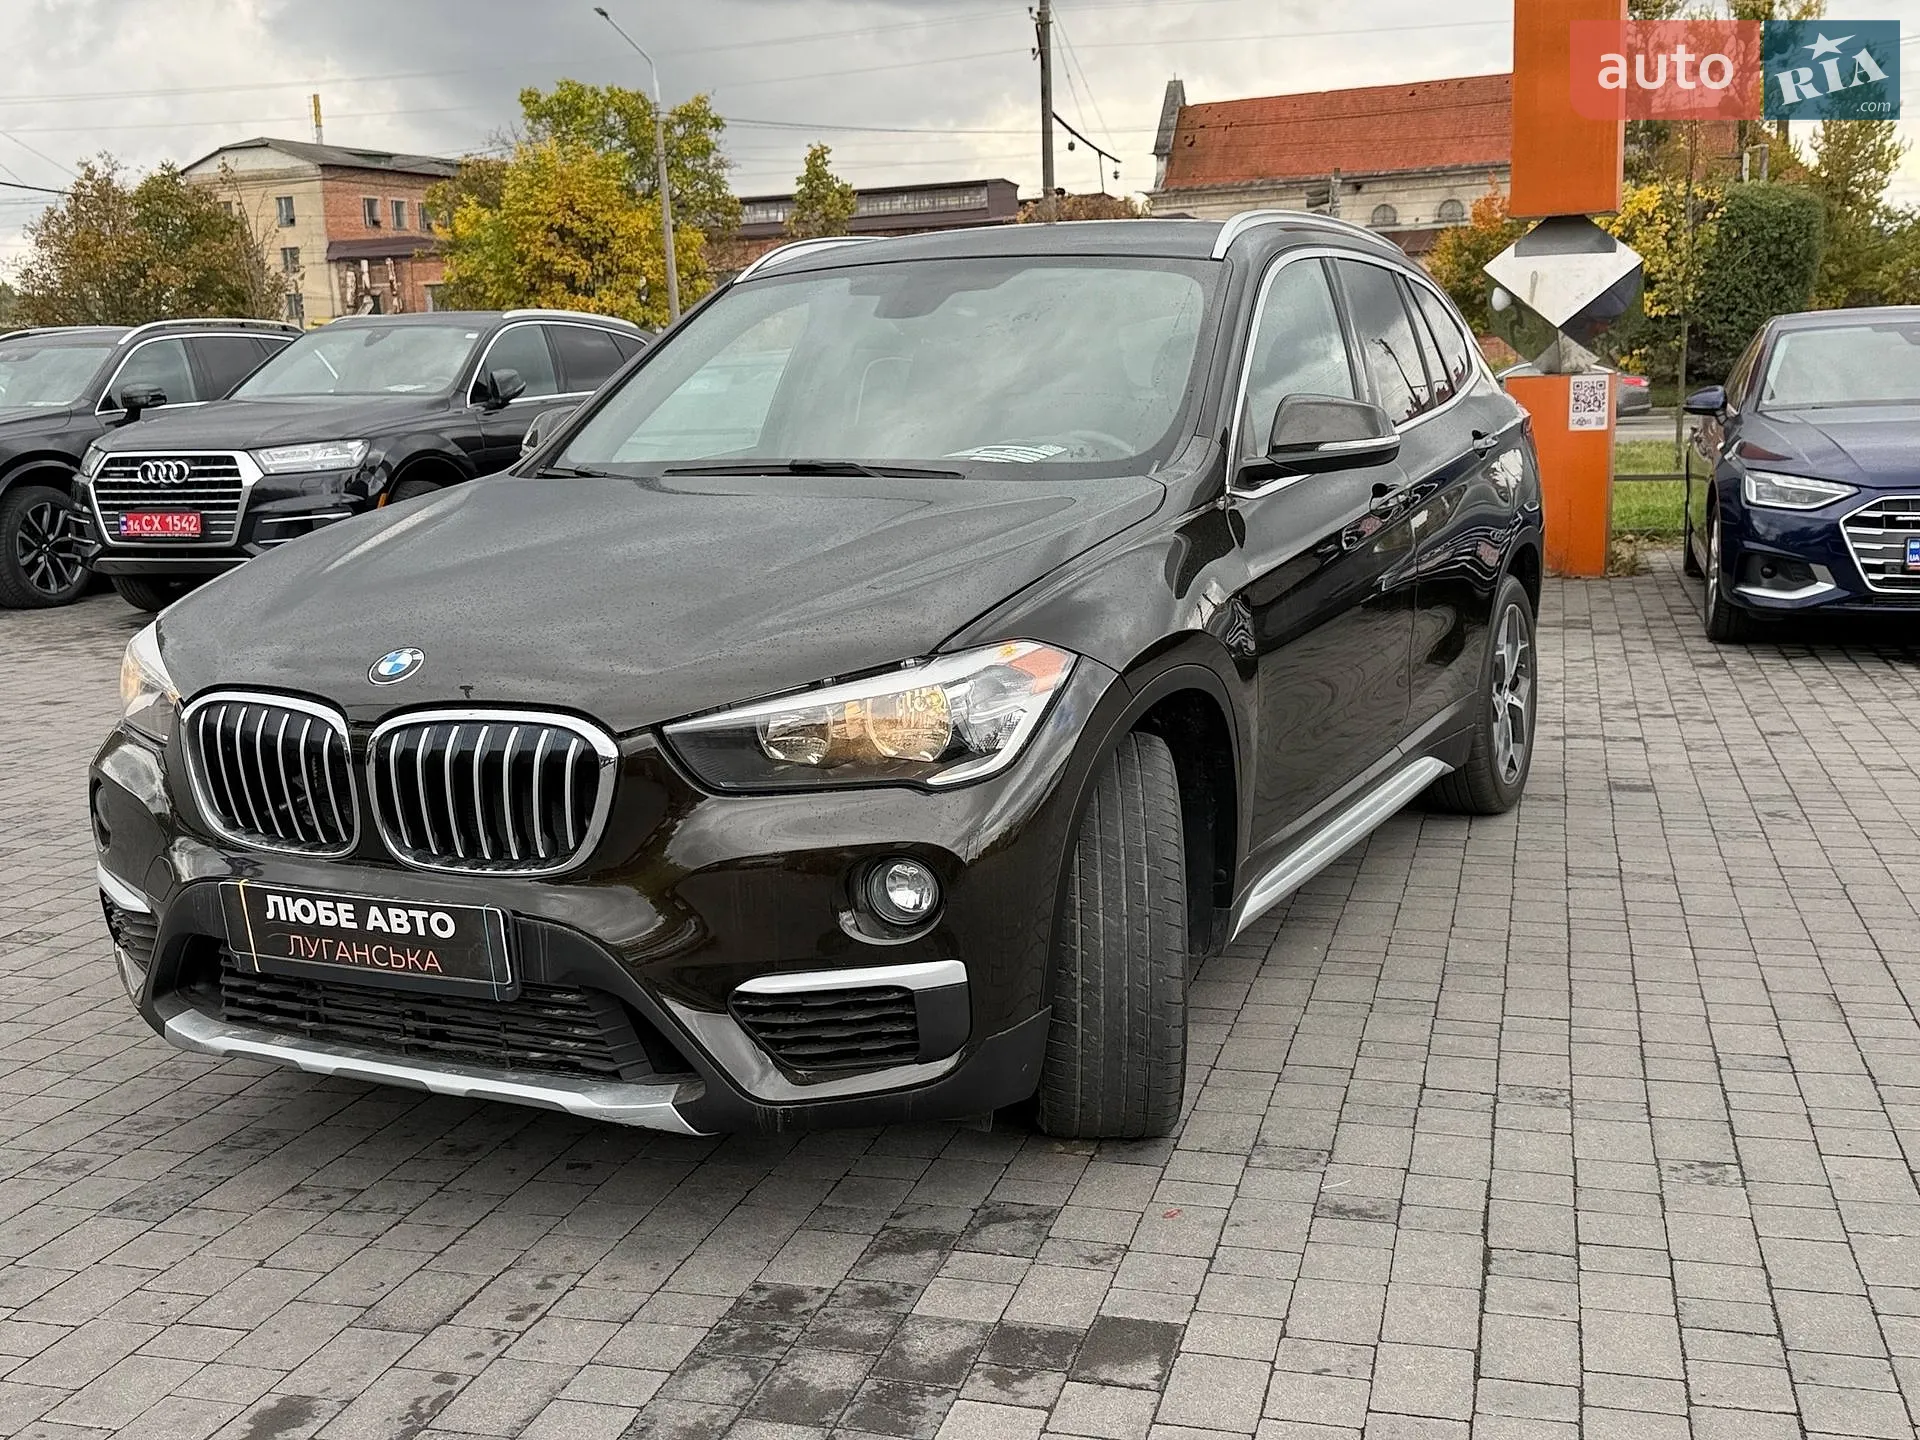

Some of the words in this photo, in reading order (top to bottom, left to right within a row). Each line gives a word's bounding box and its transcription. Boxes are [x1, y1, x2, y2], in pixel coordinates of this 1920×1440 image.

[128, 519, 140, 532] 14
[141, 515, 162, 531] CX
[165, 515, 198, 531] 1542
[266, 894, 358, 930] ЛЮБЕ
[366, 906, 456, 939] АВТО
[288, 935, 443, 973] ЛУГАНСЬКА
